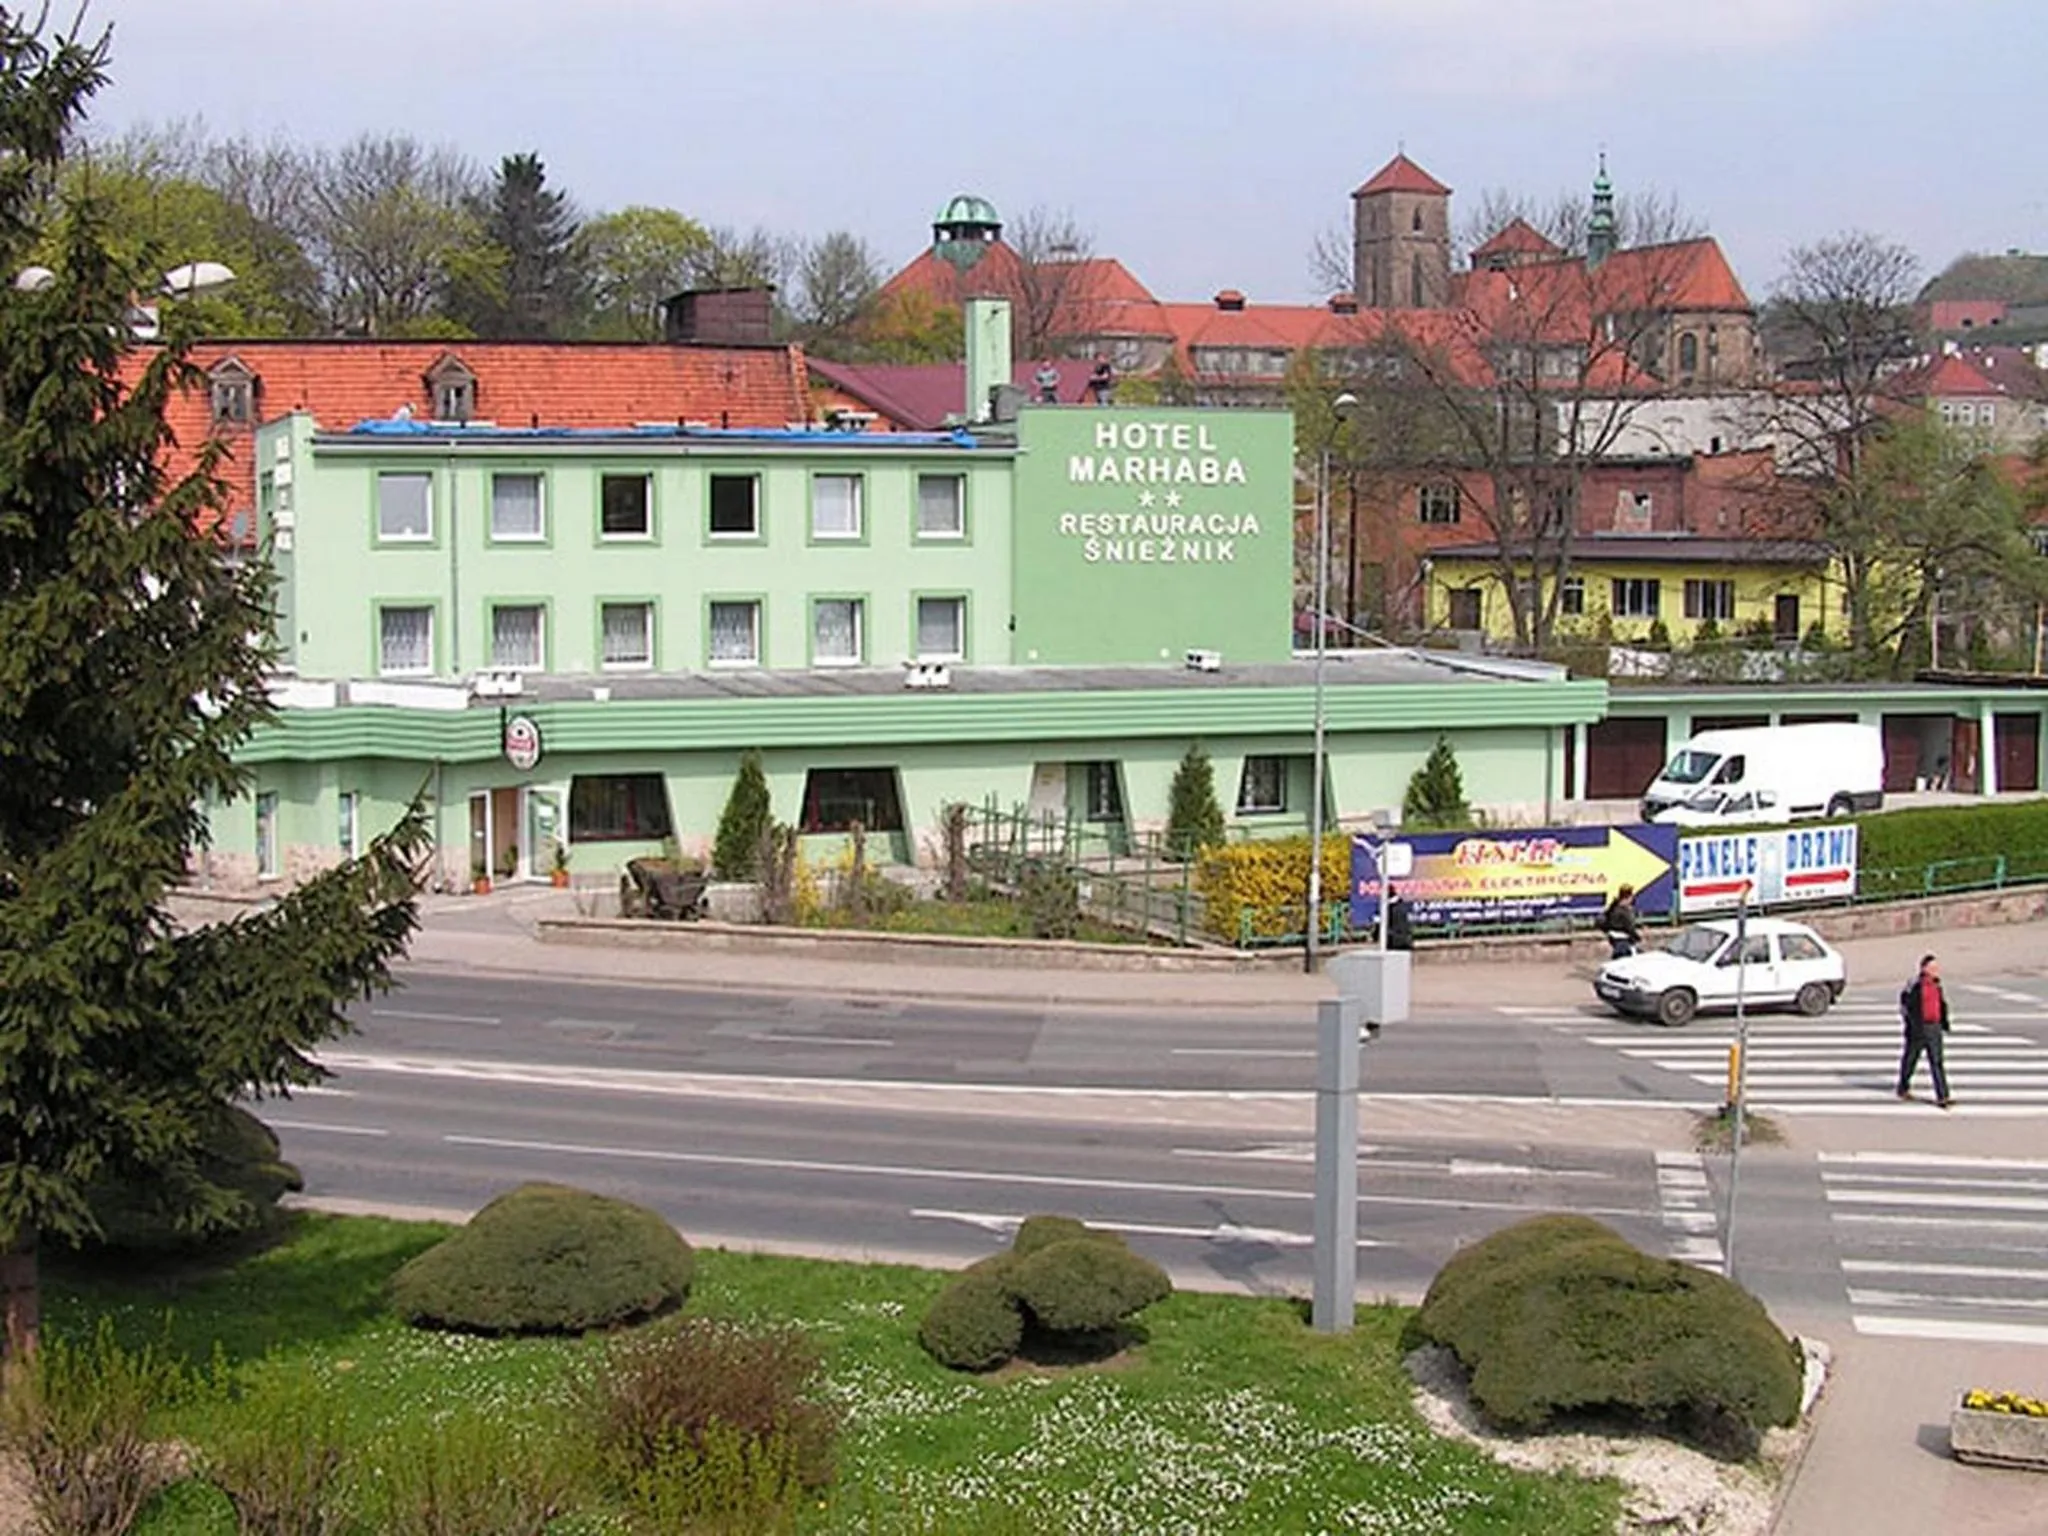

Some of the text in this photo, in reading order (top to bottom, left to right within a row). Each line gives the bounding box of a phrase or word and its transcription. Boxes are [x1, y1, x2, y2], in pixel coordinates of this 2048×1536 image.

[1096, 421, 1217, 450] HOTEL
[1069, 456, 1246, 484] MARHABA
[1060, 513, 1260, 536] RESTAURACJA
[1681, 828, 1854, 880] PANELE DRZWI
